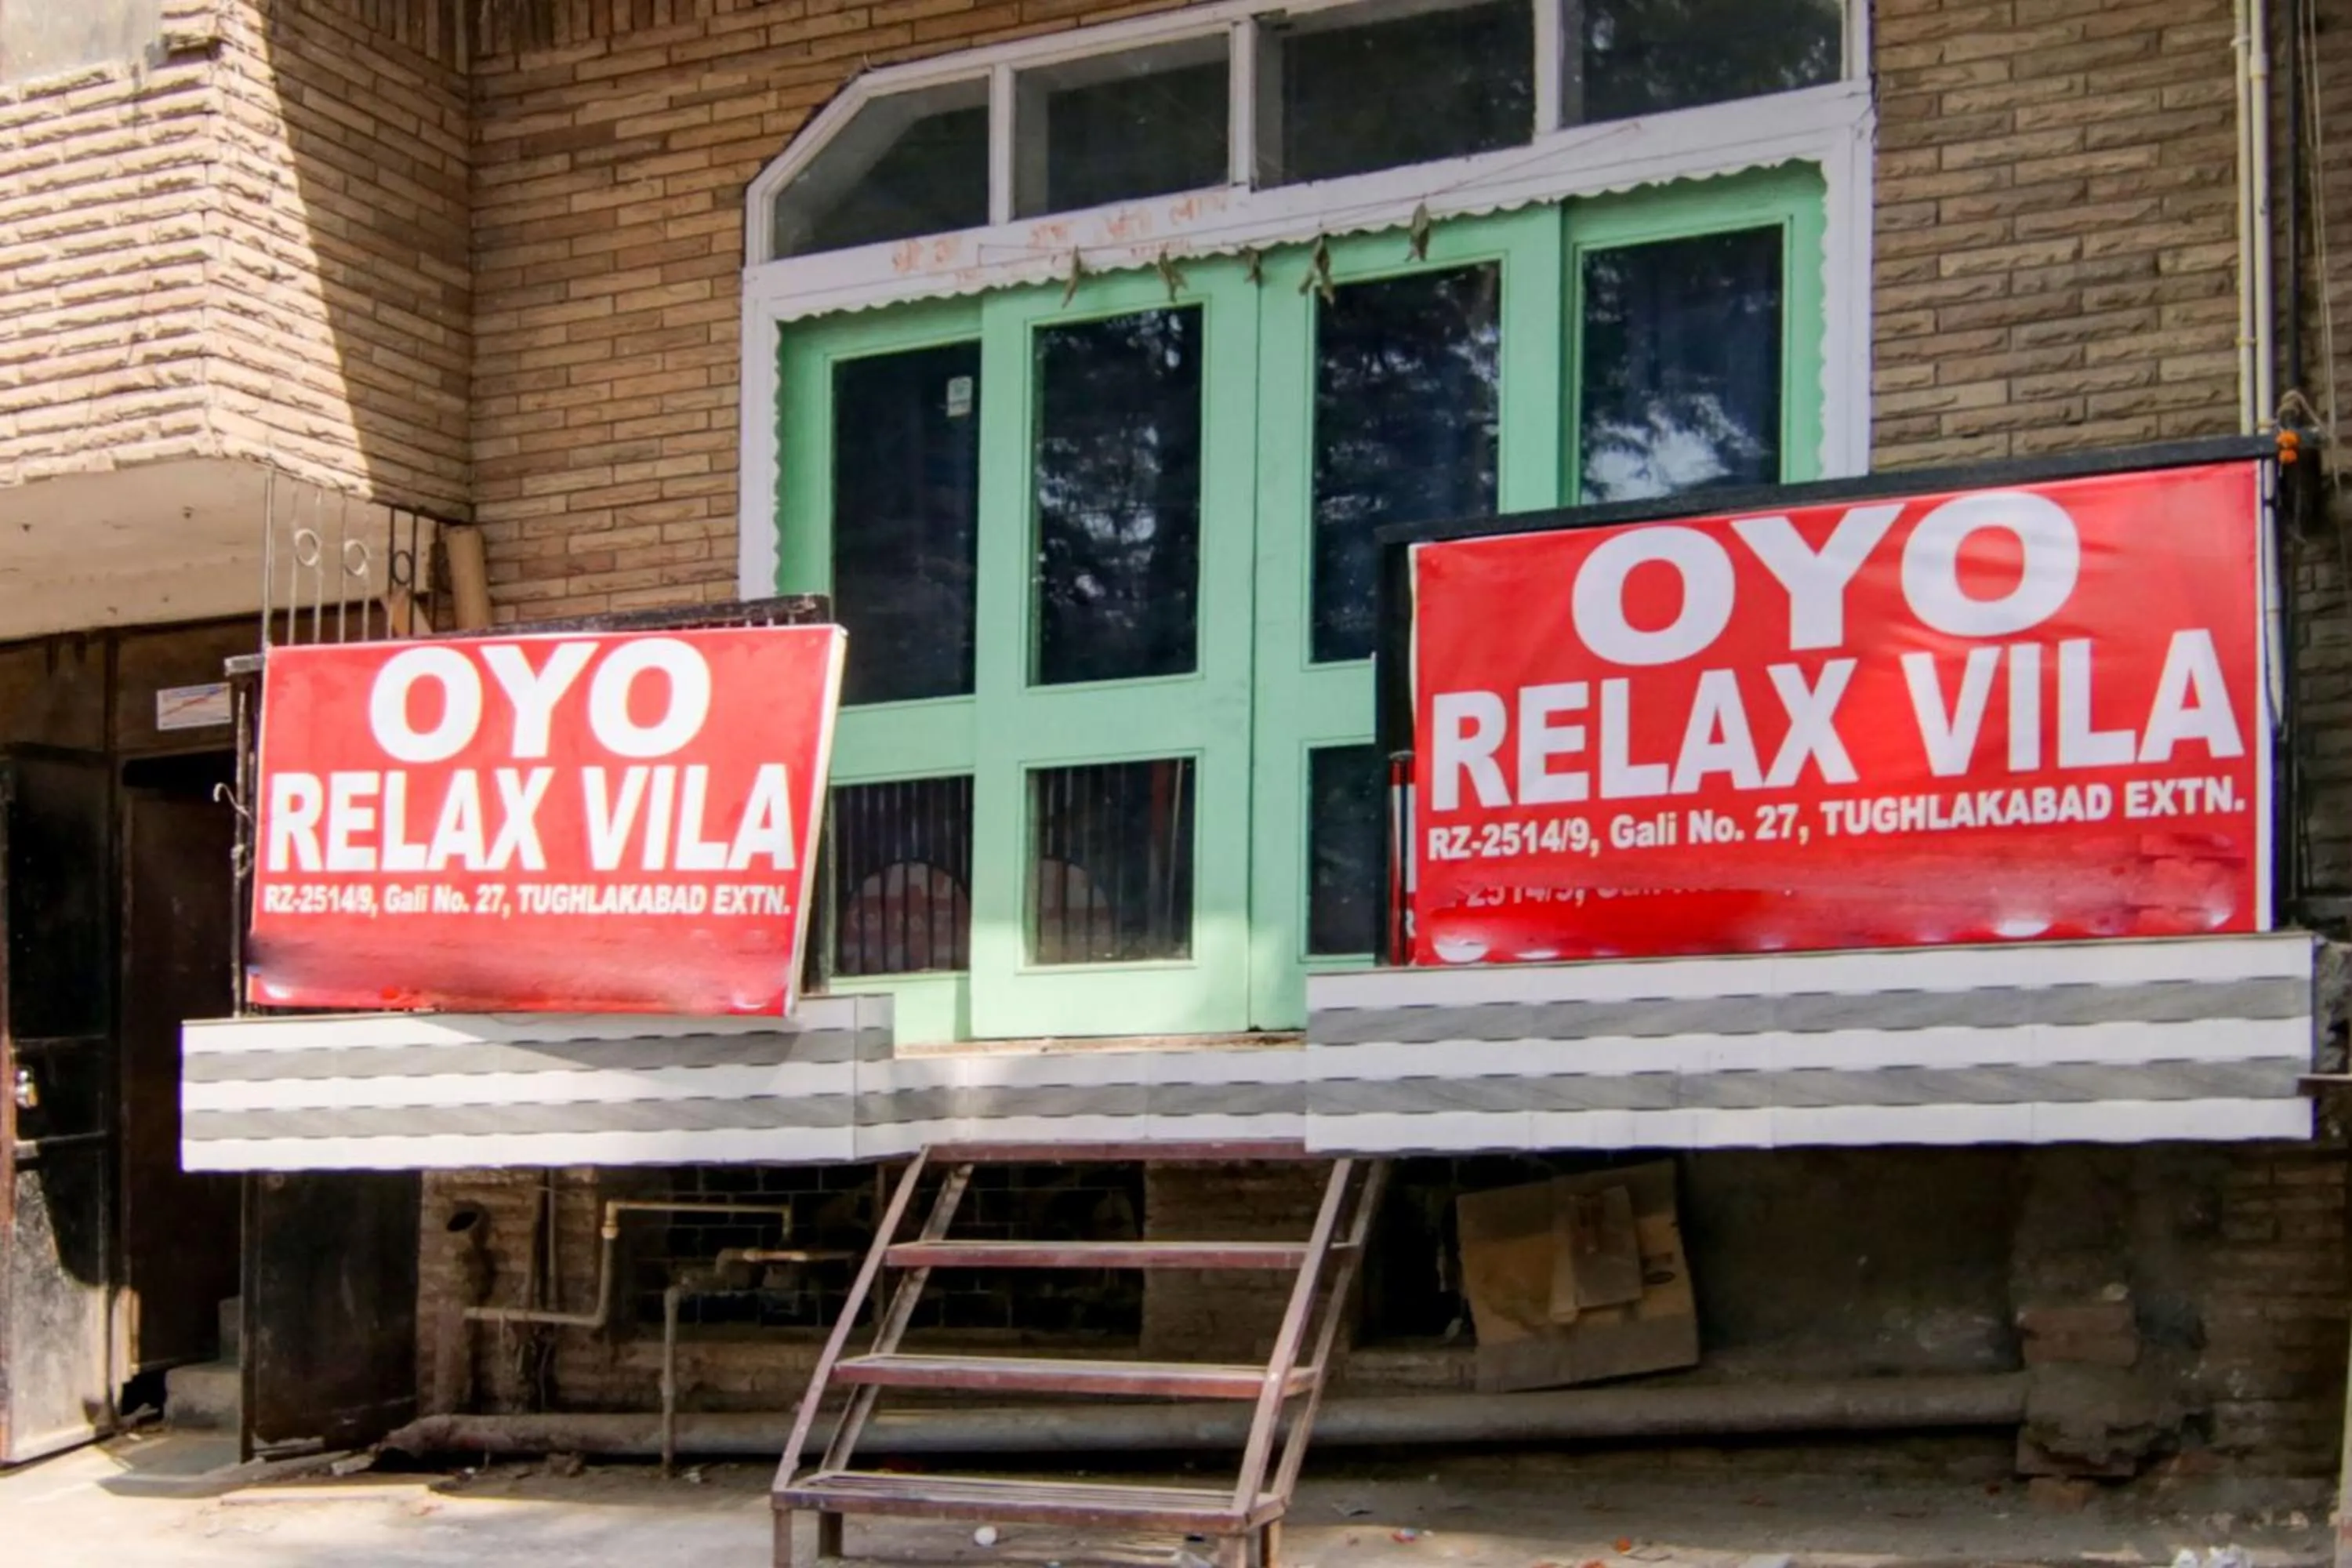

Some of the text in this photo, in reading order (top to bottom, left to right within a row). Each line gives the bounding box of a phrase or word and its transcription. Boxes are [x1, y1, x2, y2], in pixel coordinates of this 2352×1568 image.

[1572, 490, 2082, 666] OYO
[369, 637, 713, 763] OYO
[1430, 628, 2245, 811] RELAX VILA
[267, 764, 796, 873] RELAX VILA
[1428, 776, 2245, 861] RZ-2514/9, Gali No. 27, TUGHLAKABAD EXTN.
[383, 884, 430, 913] Gali
[432, 884, 470, 913] No.
[474, 884, 511, 919] 27,
[517, 884, 706, 915] TUGHLAKABAD
[711, 884, 791, 915] EXTN.
